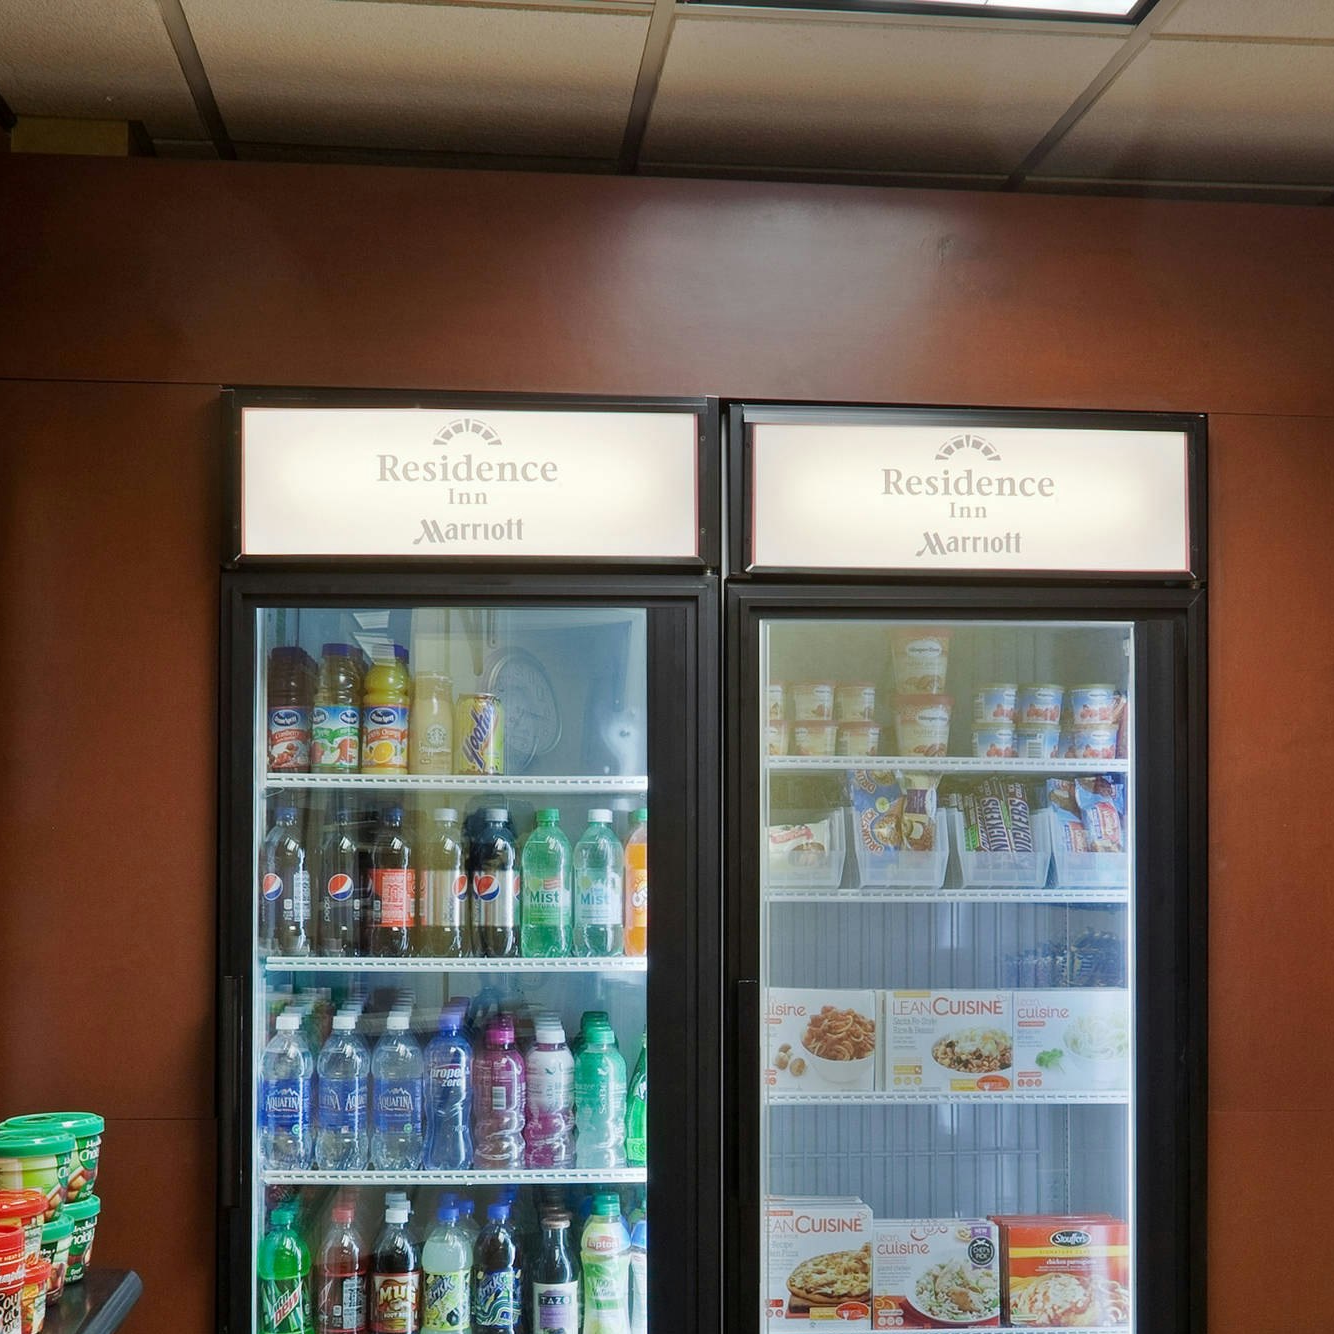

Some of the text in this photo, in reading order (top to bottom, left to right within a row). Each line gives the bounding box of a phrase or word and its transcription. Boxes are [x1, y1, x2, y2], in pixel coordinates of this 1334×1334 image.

[376, 453, 559, 483] Residence
[881, 467, 1055, 497] Residence
[447, 487, 488, 505] Inn
[948, 501, 988, 518] Inn
[412, 518, 524, 545] Marriott
[914, 531, 1022, 557] Marriott
[529, 889, 560, 904] Mist
[580, 892, 609, 906] Mist
[768, 1001, 807, 1017] isine
[892, 996, 1003, 1016] LEAN CUISINE
[1017, 1005, 1069, 1020] cuisine
[440, 1079, 463, 1088] zero
[378, 1093, 413, 1112] AQUAFINA
[795, 1216, 863, 1233] CUISINE
[587, 1236, 617, 1250] Lipton
[876, 1242, 930, 1256] cuisine
[379, 1285, 417, 1306] MUG
[540, 1296, 571, 1305] TAZO
